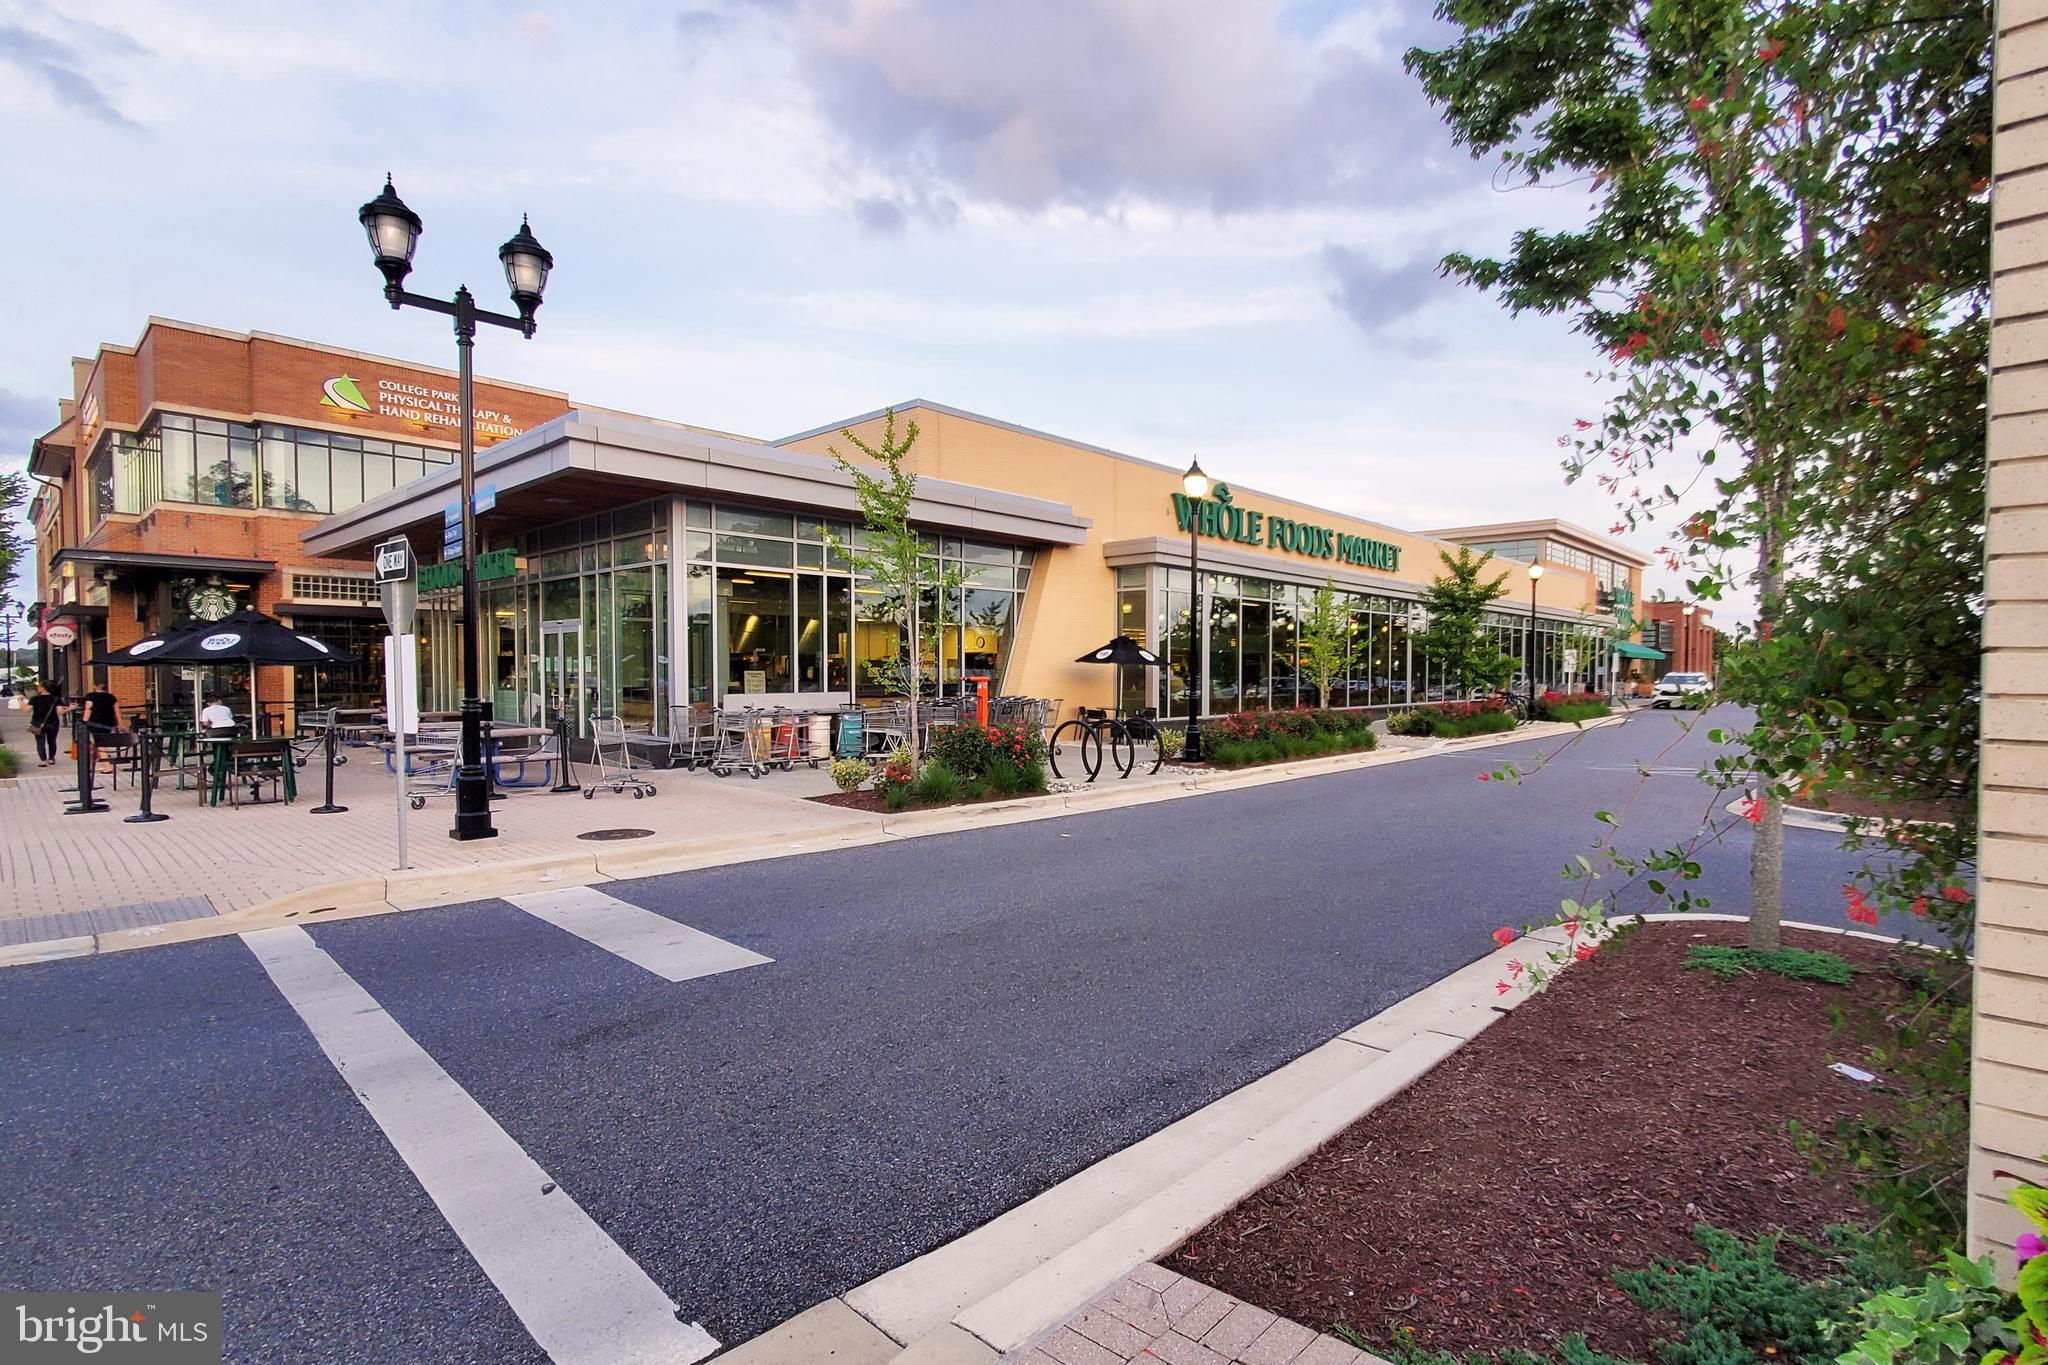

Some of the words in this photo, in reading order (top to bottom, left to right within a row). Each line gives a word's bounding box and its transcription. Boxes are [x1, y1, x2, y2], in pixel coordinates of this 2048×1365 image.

[378, 380, 429, 397] COLLEGE
[431, 390, 459, 403] PARK
[379, 392, 444, 412] PHYSICAL
[445, 403, 500, 422] THRAPY
[502, 413, 512, 425] &
[379, 404, 421, 421] HAND
[1171, 491, 1264, 546] WHOLE
[1268, 515, 1334, 560] FOODS
[1336, 532, 1402, 572] MARKET
[383, 554, 393, 569] ONE
[393, 551, 404, 568] WAY
